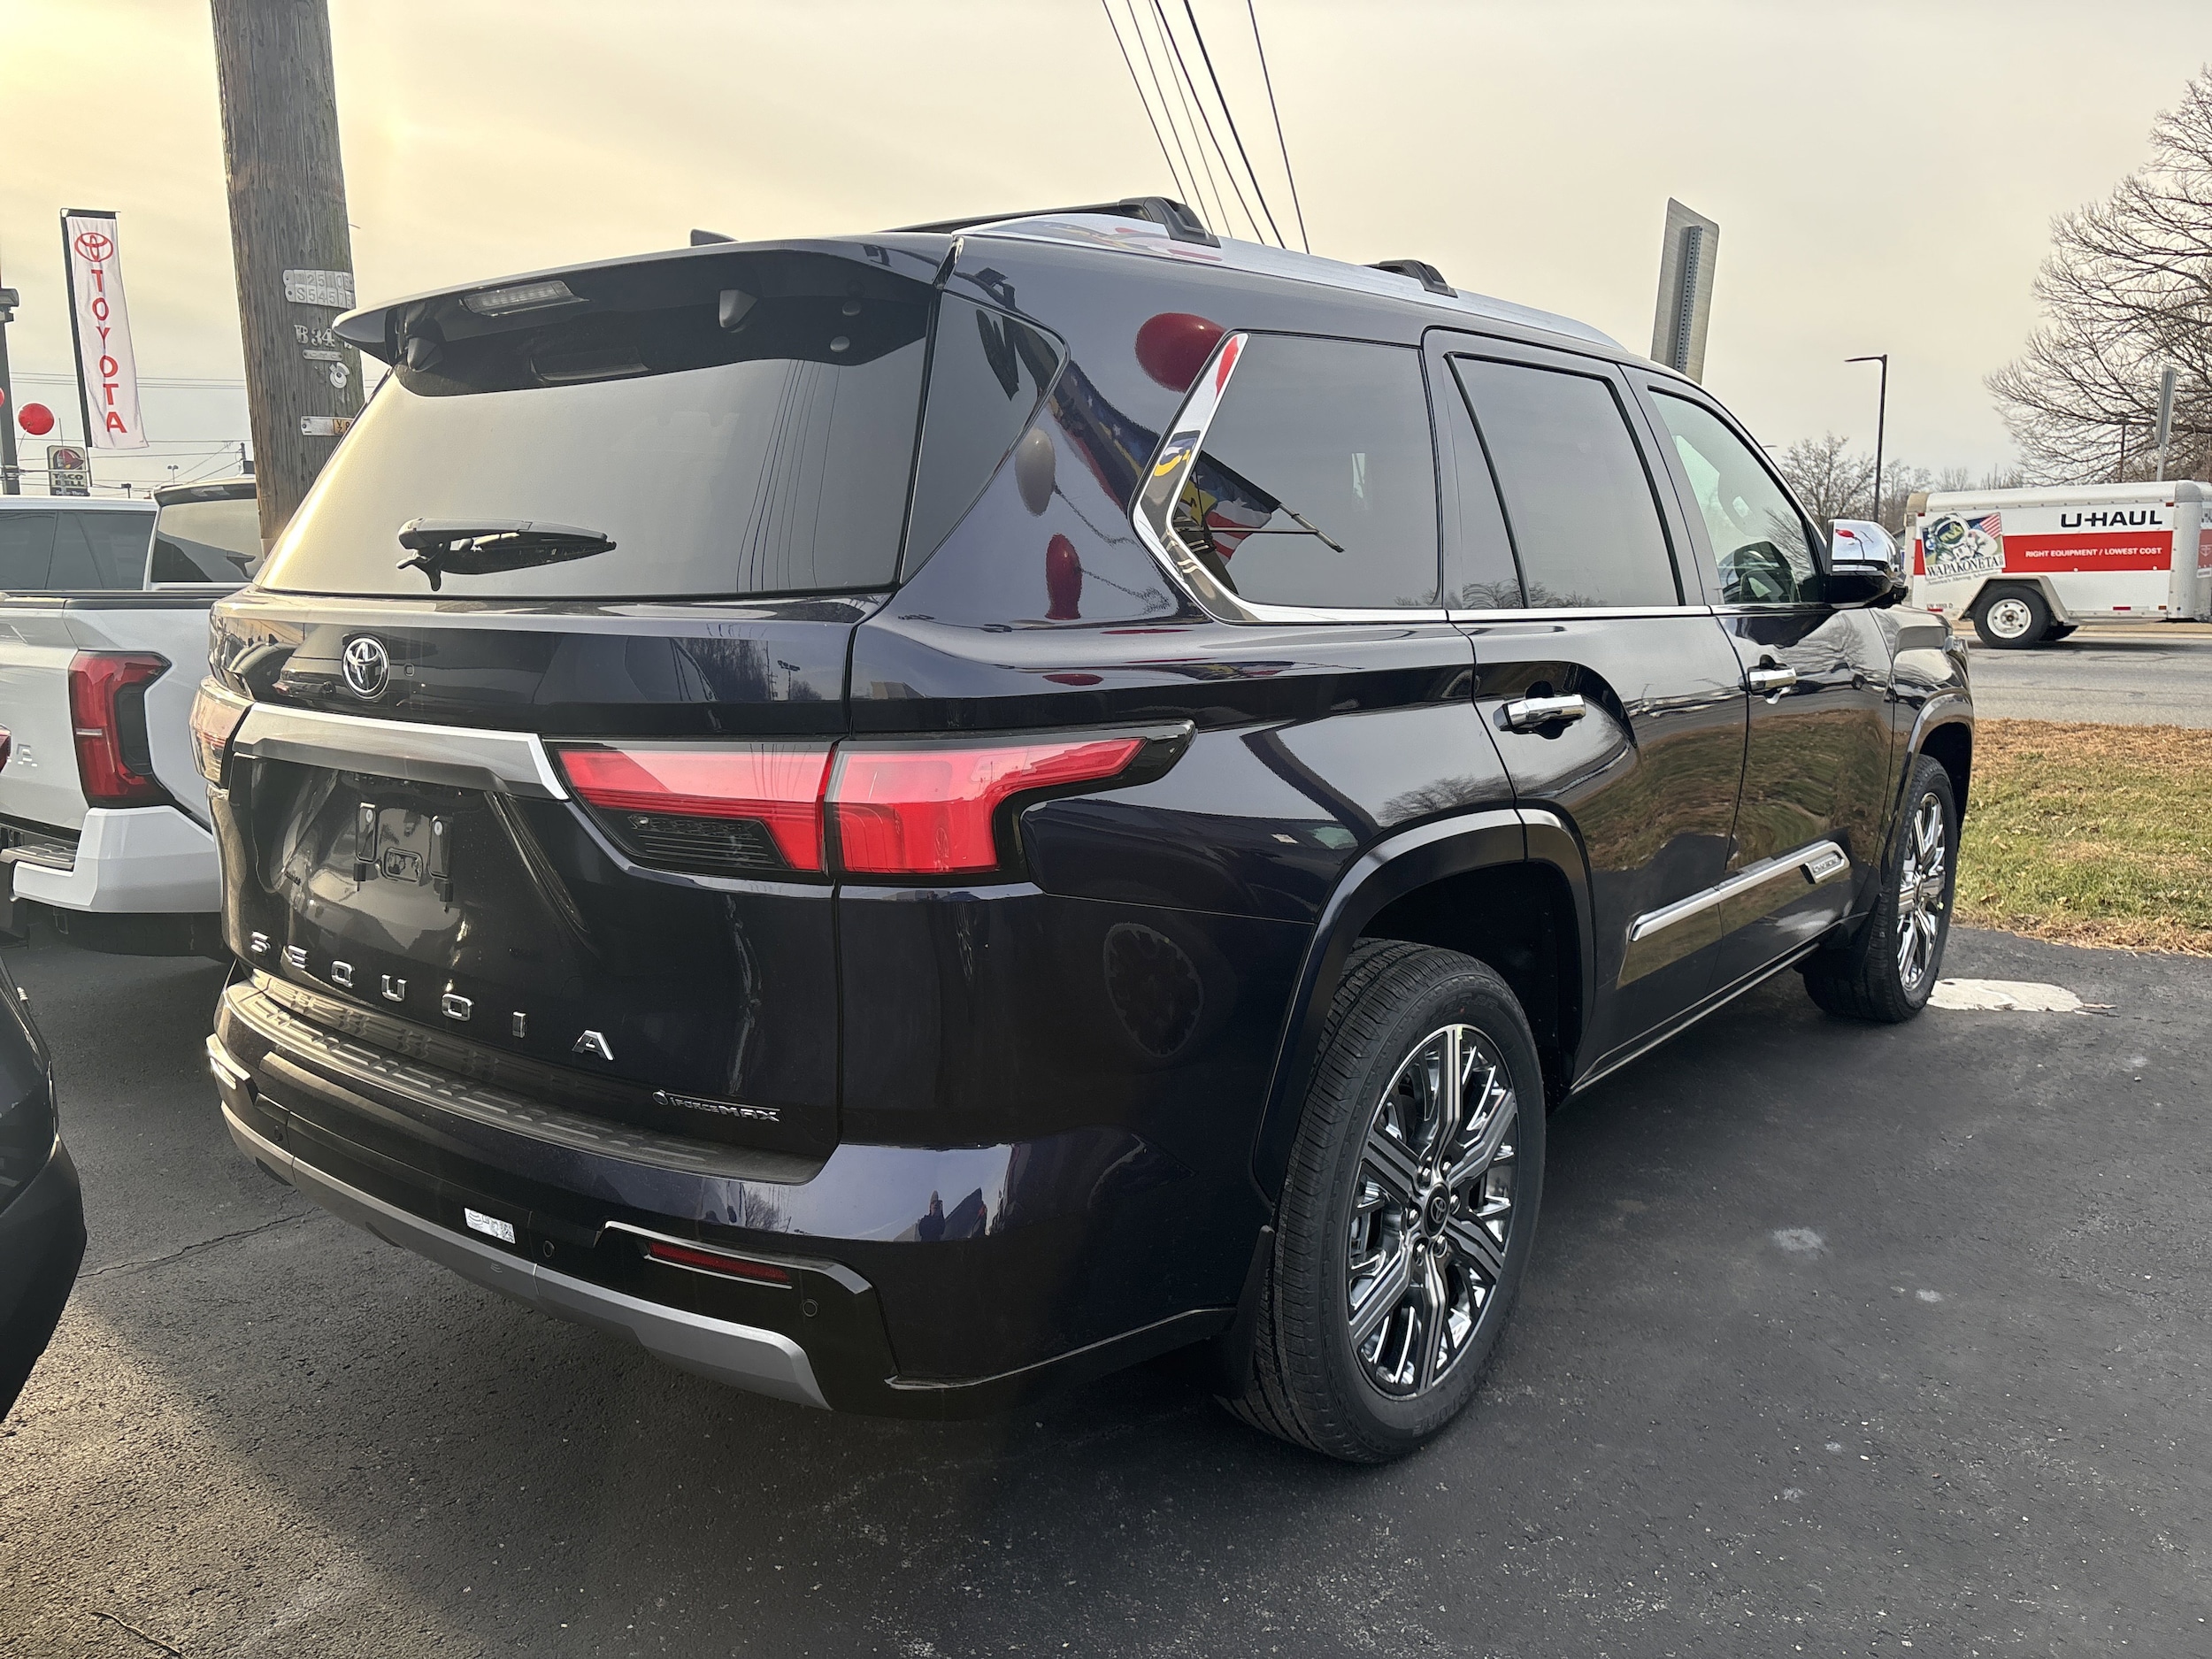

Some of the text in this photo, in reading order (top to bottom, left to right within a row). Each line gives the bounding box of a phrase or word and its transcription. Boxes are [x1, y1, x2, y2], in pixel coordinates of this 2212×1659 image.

[91, 269, 127, 434] TOYOTA
[2061, 510, 2163, 528] U-HAUL
[2025, 549, 2049, 558] RIGHT
[2050, 549, 2098, 557] EQUIPMENT
[2139, 547, 2162, 556] COST
[1925, 556, 2000, 578] WAPAKONETA
[250, 930, 616, 1062] SEQUOIA
